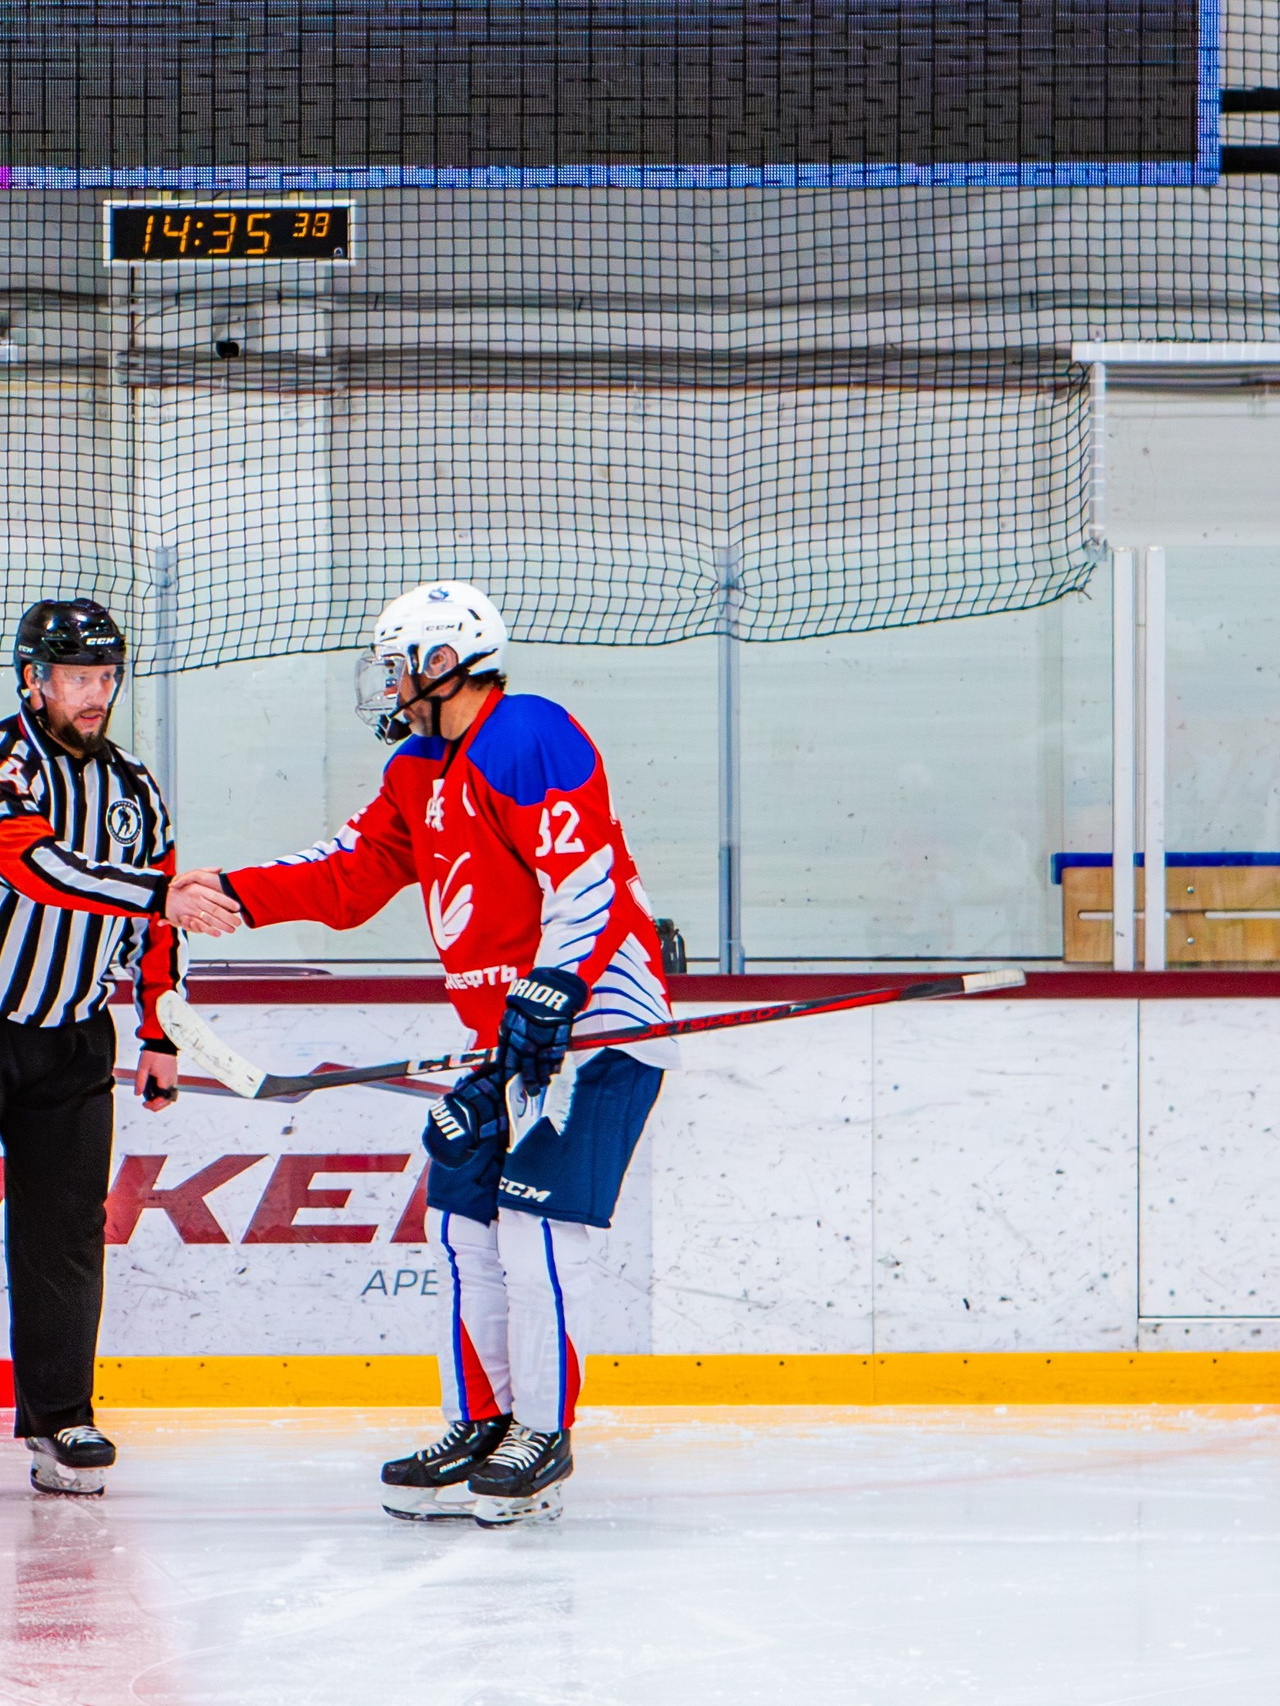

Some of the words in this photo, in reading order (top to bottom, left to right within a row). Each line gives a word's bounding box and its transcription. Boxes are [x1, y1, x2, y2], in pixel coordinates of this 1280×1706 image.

[141, 213, 271, 255] 14:35
[292, 212, 330, 238] 38
[86, 637, 115, 646] CCM
[638, 1006, 780, 1038] JETSPEED
